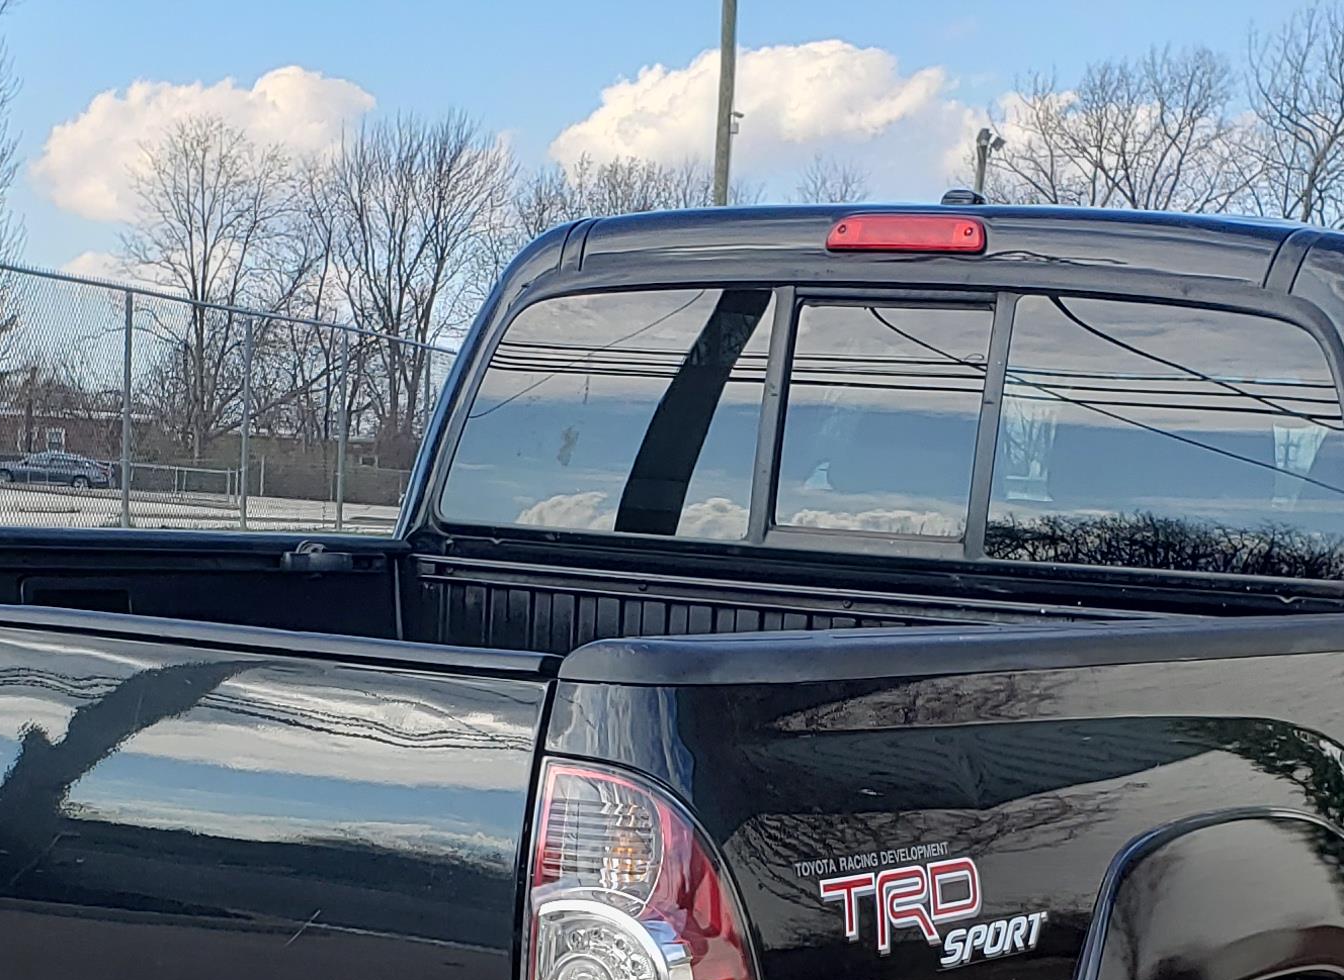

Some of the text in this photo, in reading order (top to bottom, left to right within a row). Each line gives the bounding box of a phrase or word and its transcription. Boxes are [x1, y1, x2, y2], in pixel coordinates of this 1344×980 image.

[795, 841, 949, 877] TOYOTA RACING DEVELOPMENT
[819, 857, 982, 956] TRD
[940, 911, 1049, 968] SPORT
